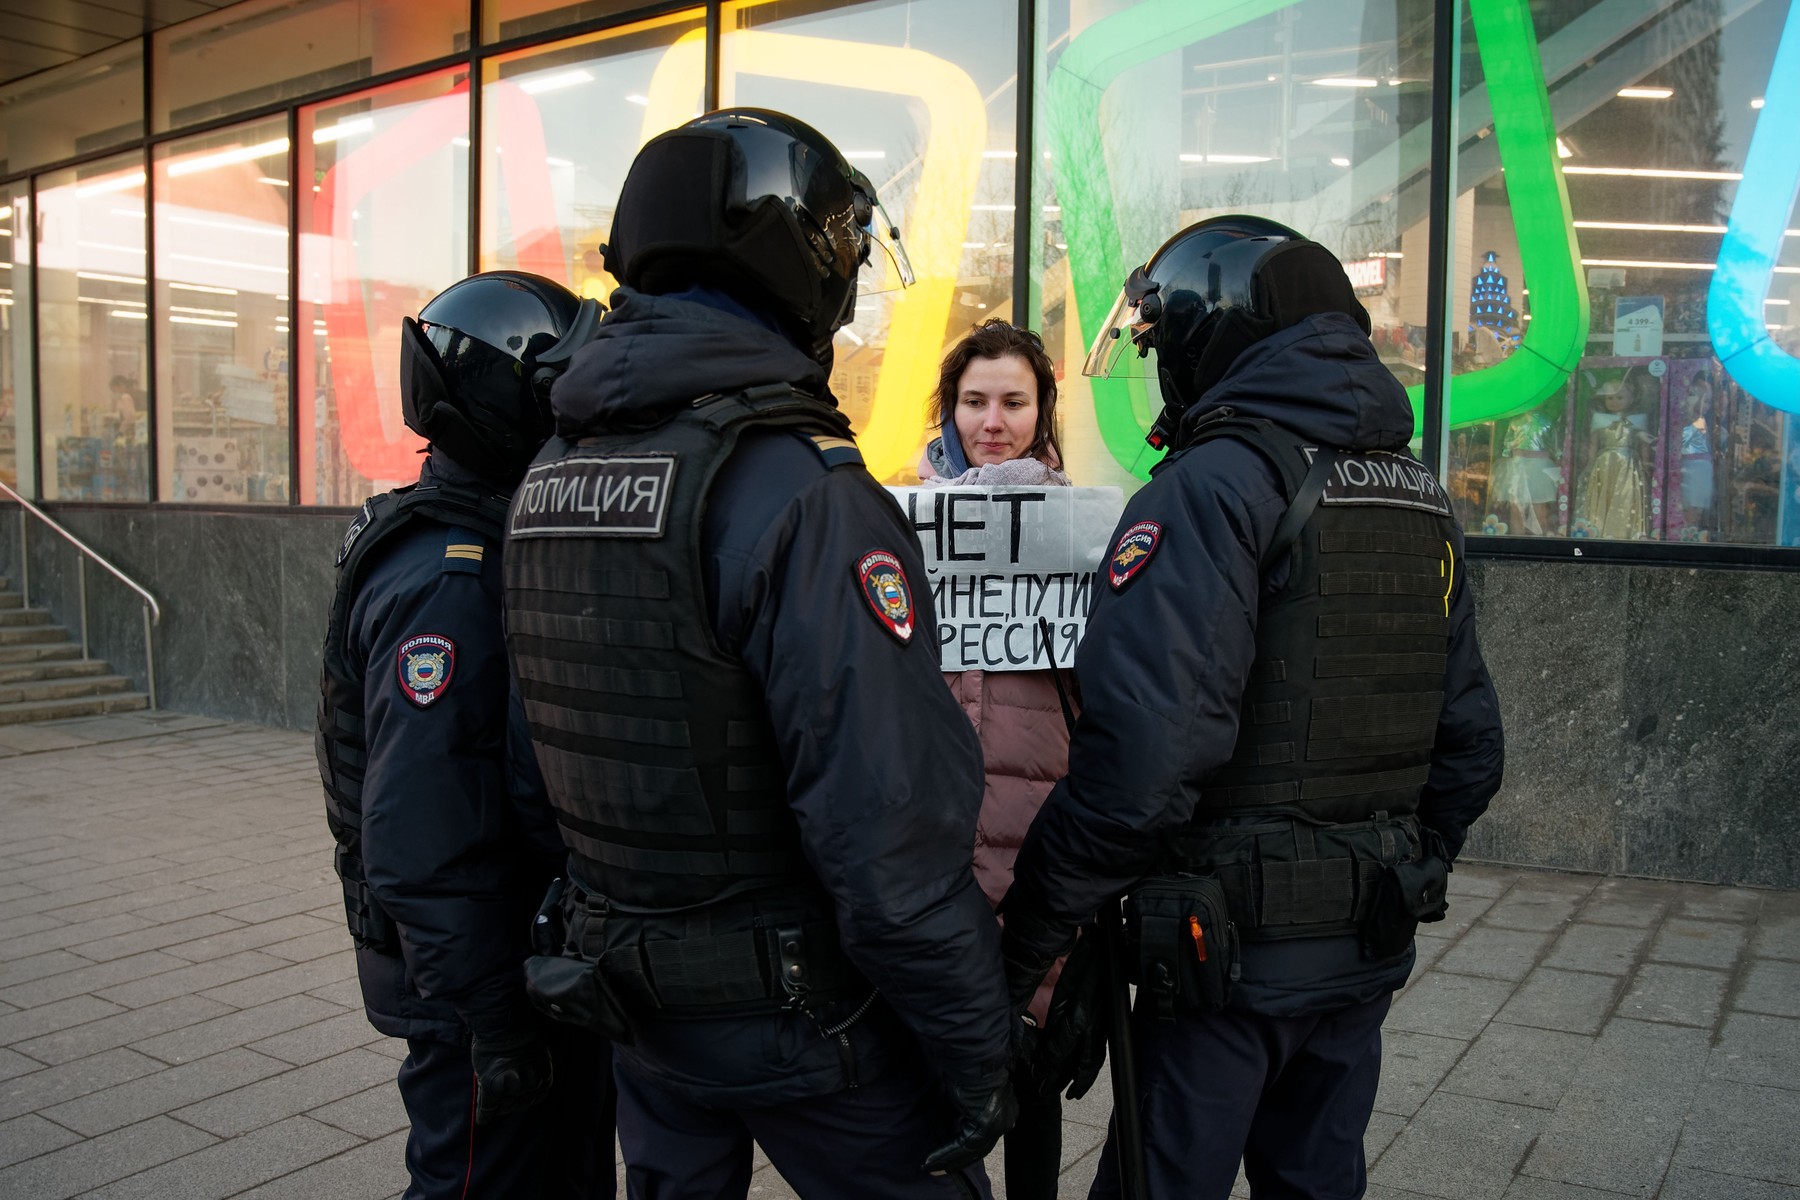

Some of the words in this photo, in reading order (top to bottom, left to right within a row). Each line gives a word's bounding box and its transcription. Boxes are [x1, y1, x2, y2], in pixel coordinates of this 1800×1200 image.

[516, 475, 660, 522] ПОЛИЦИЯ
[908, 493, 1046, 563] НЕТ
[1011, 572, 1097, 618] ПУТИ
[401, 637, 452, 654] ПОЛИЦИЯ
[415, 692, 435, 704] МВД
